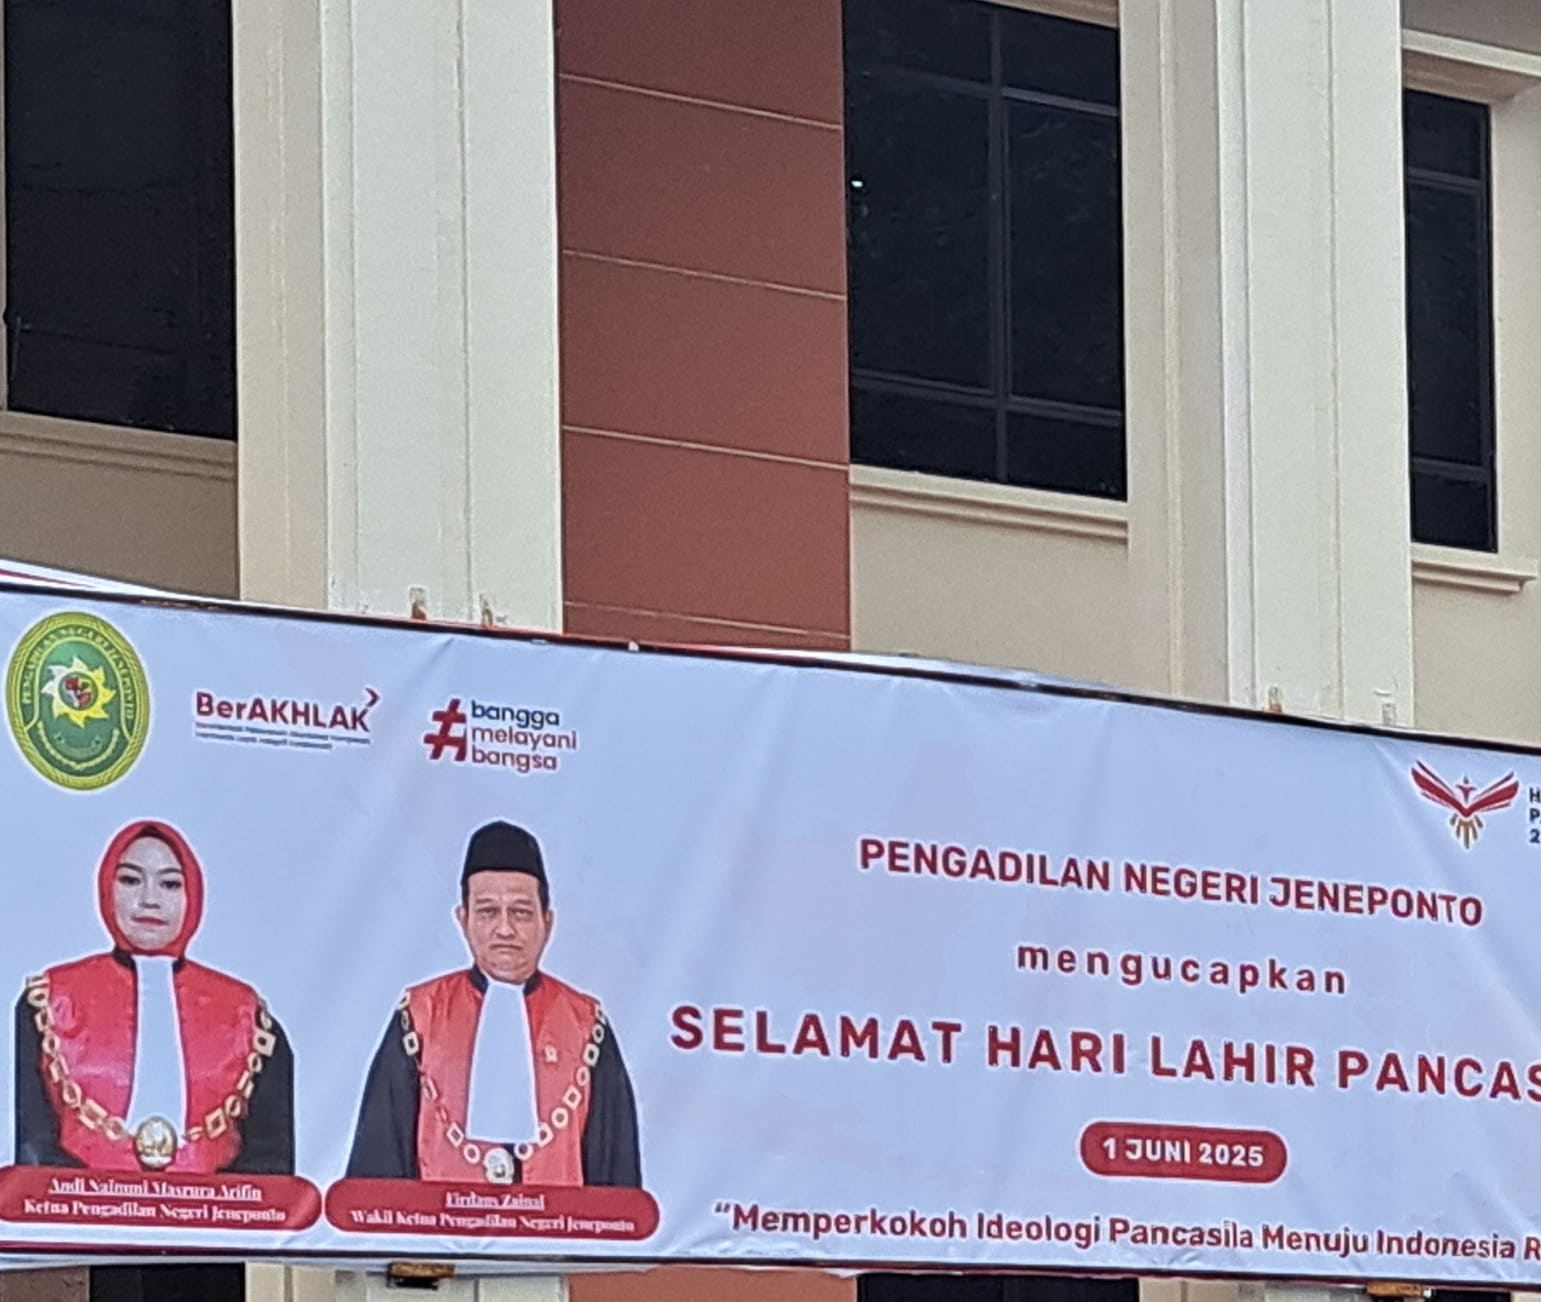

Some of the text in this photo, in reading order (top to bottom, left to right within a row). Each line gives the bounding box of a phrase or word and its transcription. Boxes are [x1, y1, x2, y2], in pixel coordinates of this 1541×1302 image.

[196, 690, 370, 733] BerAKHLAK
[471, 700, 560, 730] bangga
[471, 726, 577, 750] melayani
[471, 744, 557, 773] bangsa
[860, 838, 1482, 927] PENGADILAN NEGERI JENEPONTO
[1018, 945, 1345, 994] mengucapkan
[671, 1005, 962, 1064] SELAMAT
[988, 1025, 1125, 1074] HARI
[1151, 1035, 1315, 1087] LAHIR
[1103, 1137, 1264, 1167] 1 JUNI 2025
[977, 1212, 1101, 1250] Ideologi
[1109, 1217, 1254, 1249] Pancasila
[1262, 1224, 1369, 1259] Menuju
[1376, 1230, 1516, 1259] Indonesia
